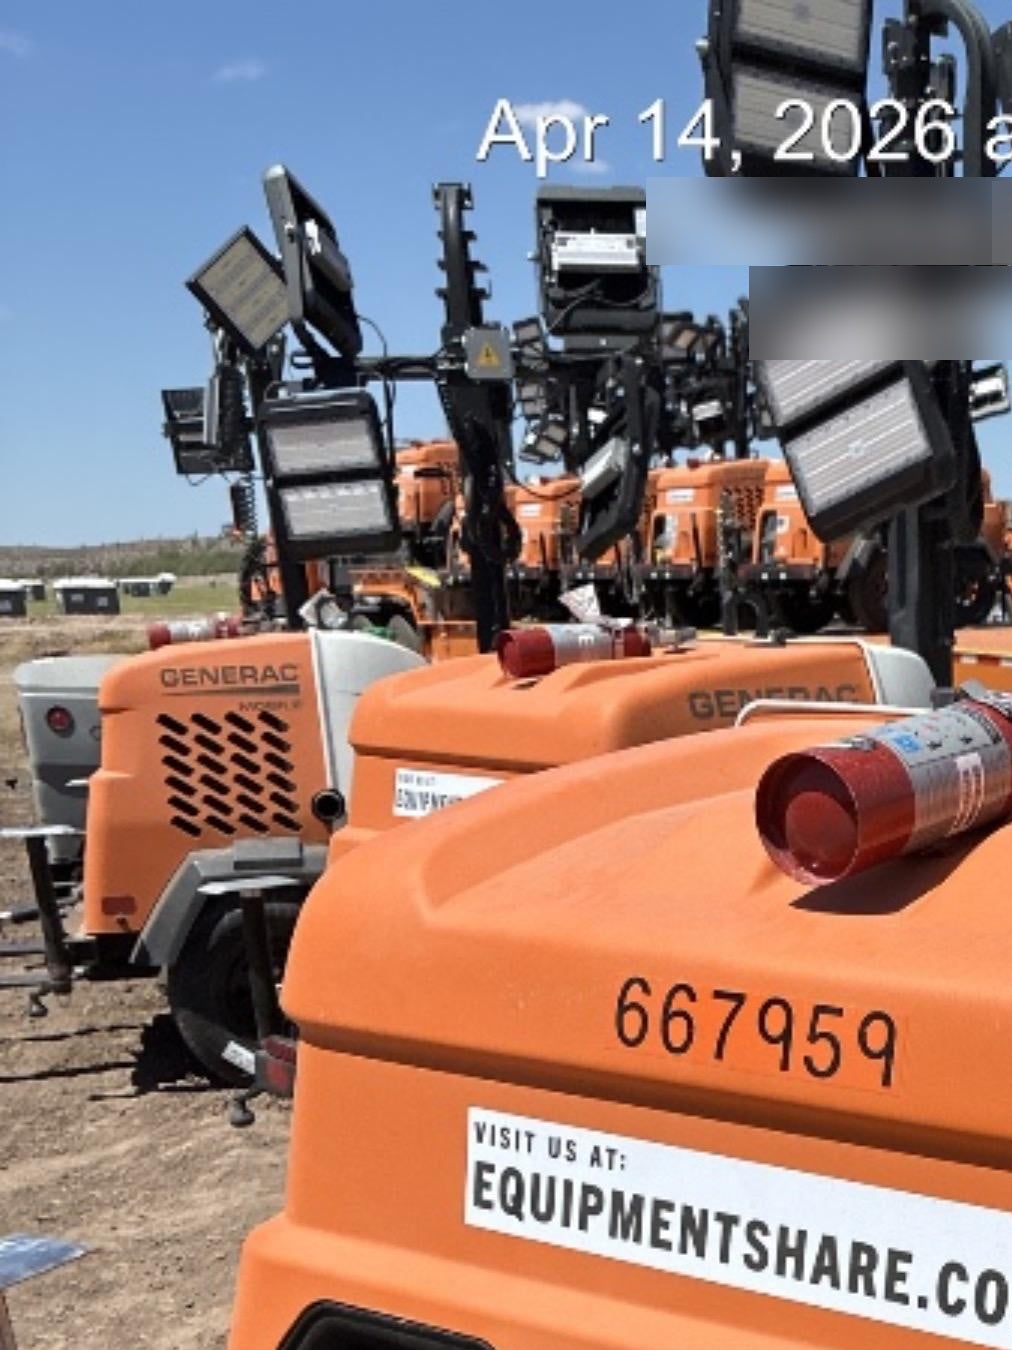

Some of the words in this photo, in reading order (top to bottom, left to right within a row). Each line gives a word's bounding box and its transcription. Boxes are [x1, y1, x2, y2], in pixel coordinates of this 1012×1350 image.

[160, 662, 298, 688] GENERAC
[614, 976, 897, 1088] 667959
[474, 1121, 536, 1154] VISIT
[548, 1135, 577, 1162] US
[590, 1145, 627, 1171] AT:
